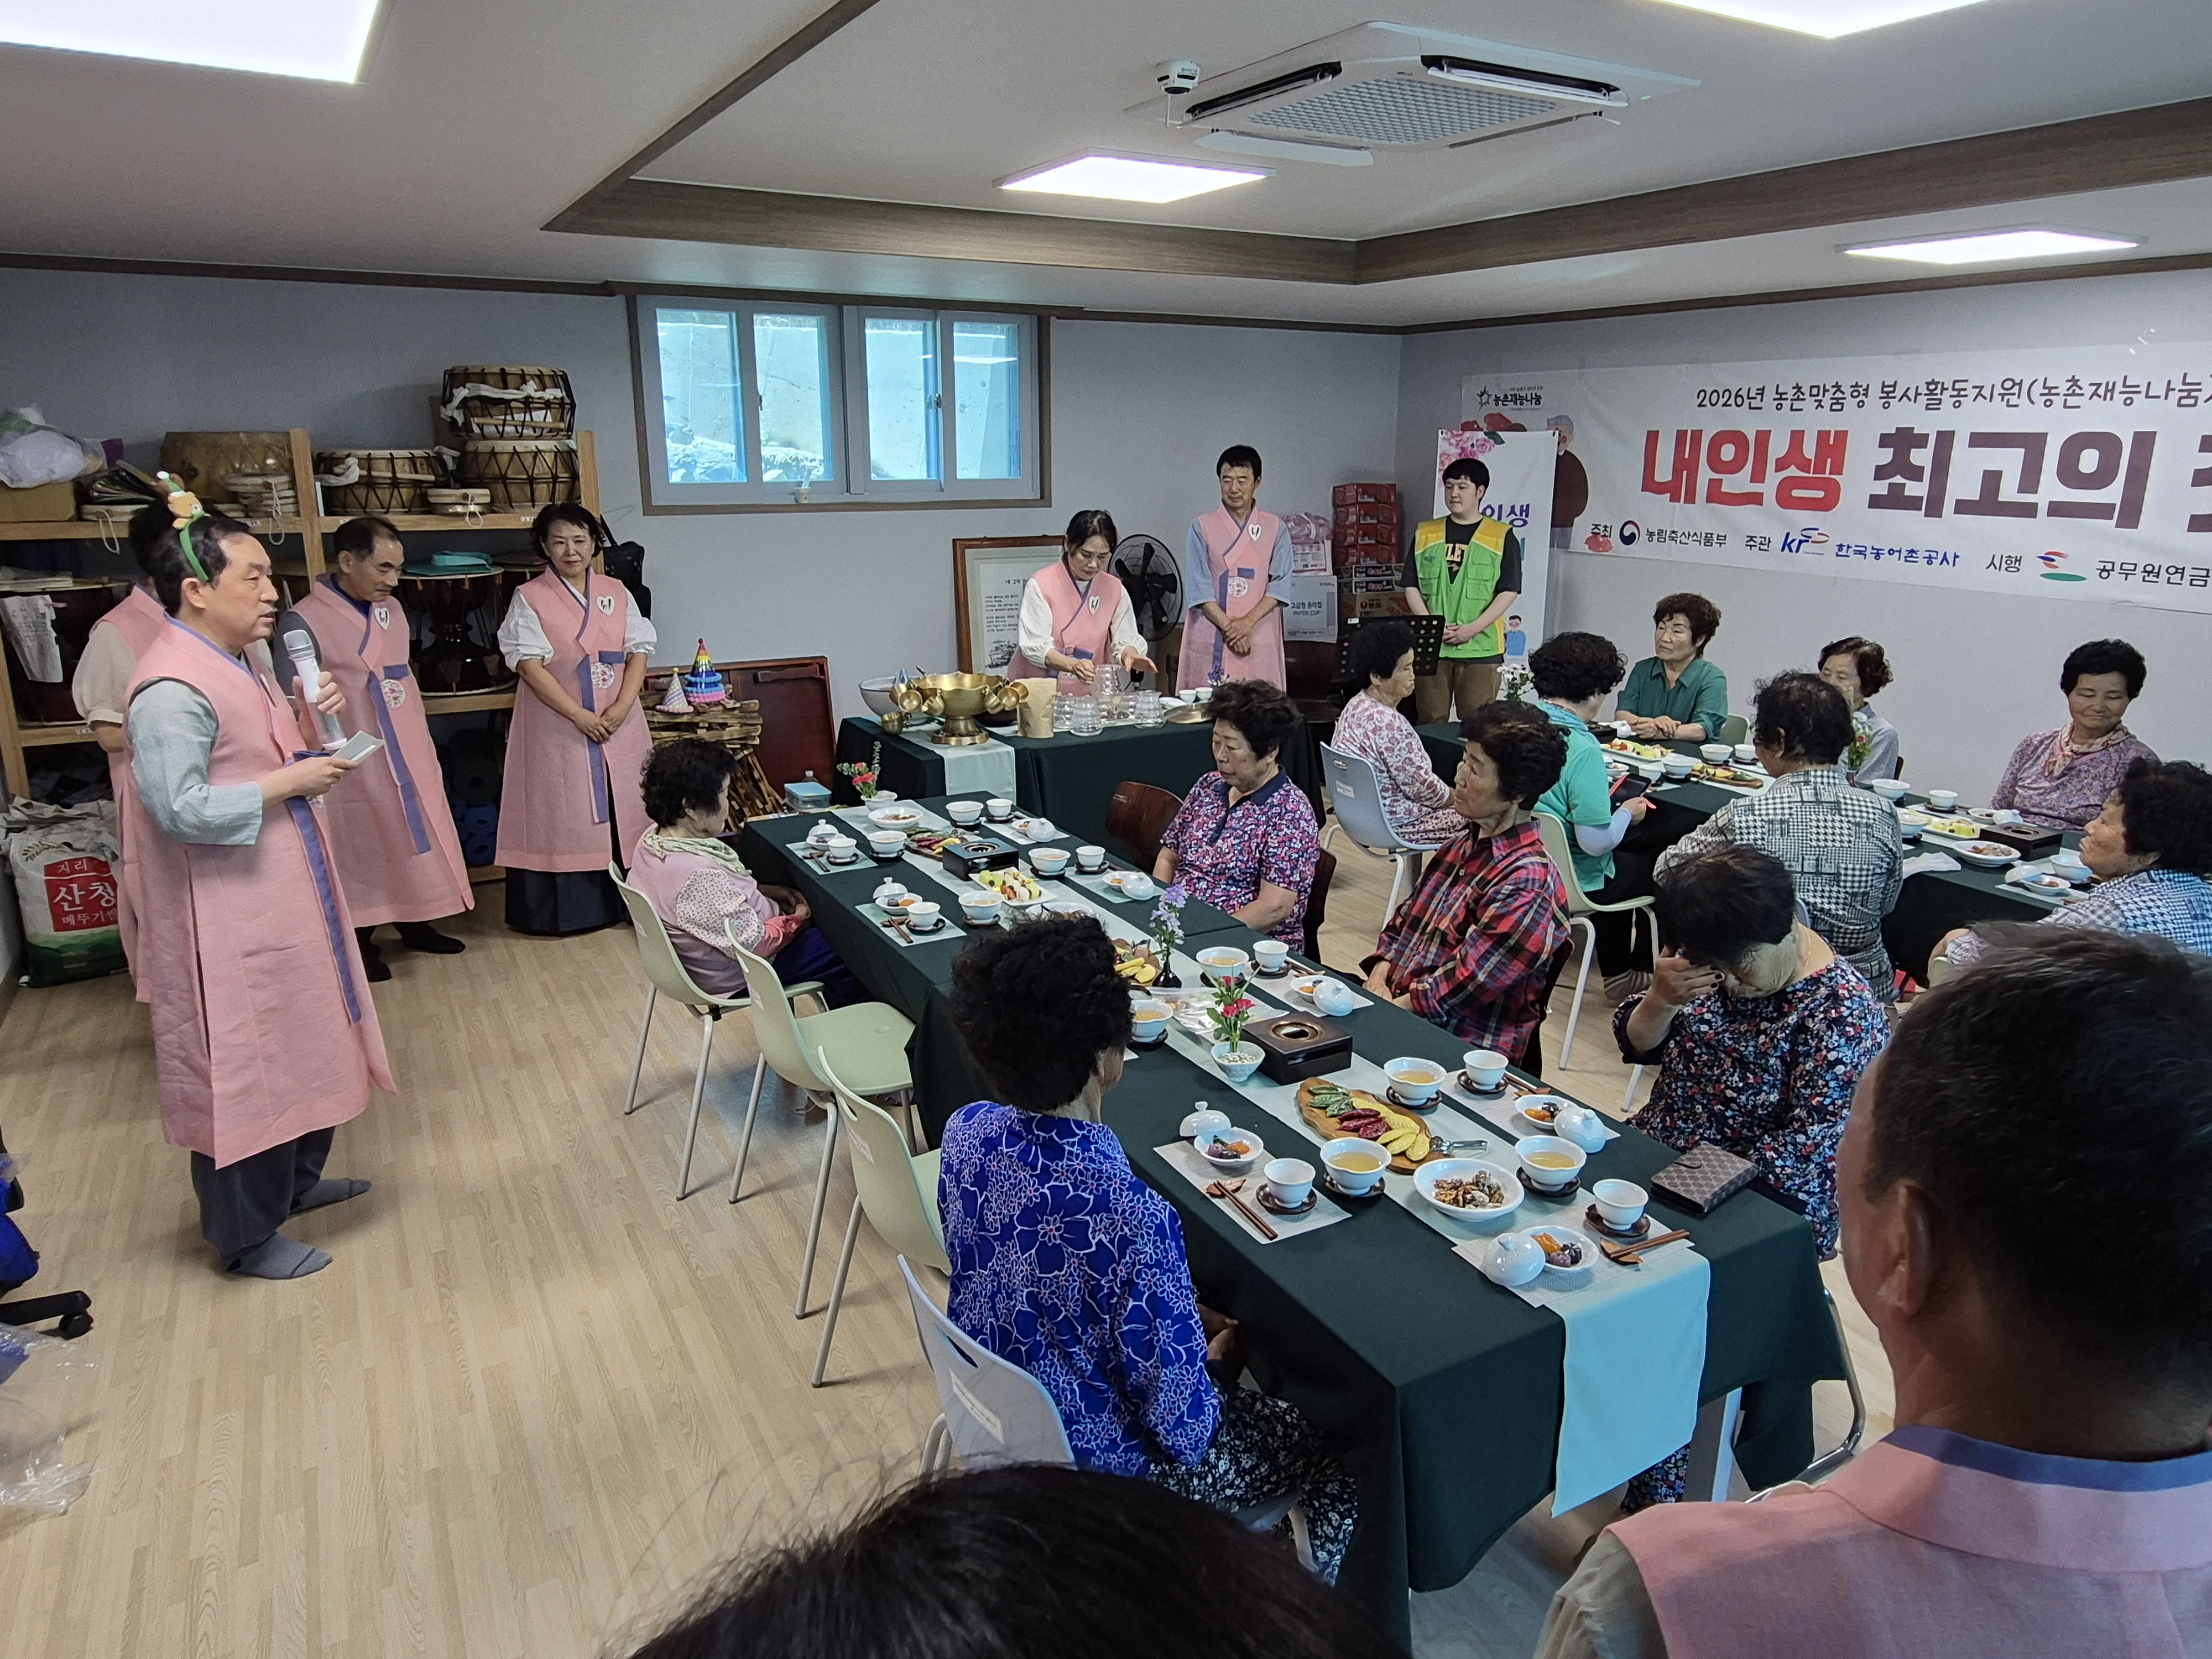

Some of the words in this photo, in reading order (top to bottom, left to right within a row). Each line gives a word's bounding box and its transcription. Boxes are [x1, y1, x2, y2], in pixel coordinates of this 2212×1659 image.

[1697, 385, 1766, 410] 2026년
[1772, 381, 1870, 412] 농촌맞춤형
[1641, 429, 1849, 512] 내인생
[1867, 426, 2157, 529] 최고의
[1590, 523, 1613, 539] 주최
[1645, 528, 1728, 548] 농림축산식품부
[1745, 535, 1772, 552] 주관
[1835, 542, 1960, 567] 한국농어촌공사
[1985, 554, 2022, 573] 시행
[2095, 560, 2211, 587] 공무원연금
